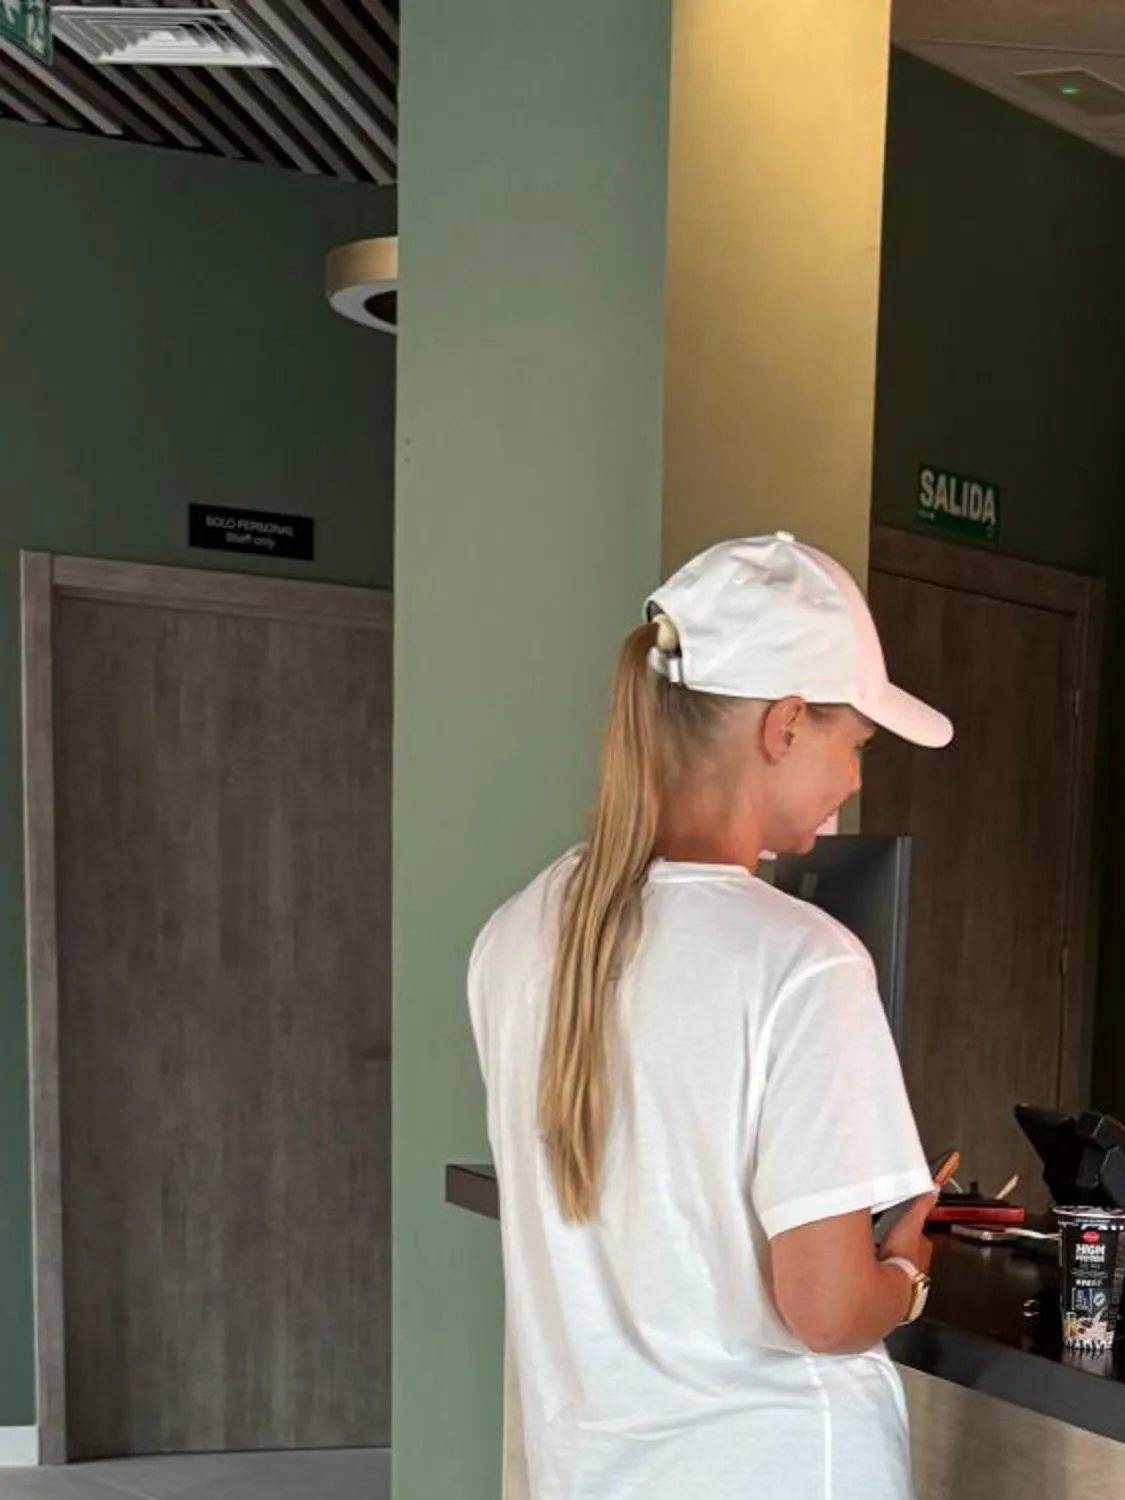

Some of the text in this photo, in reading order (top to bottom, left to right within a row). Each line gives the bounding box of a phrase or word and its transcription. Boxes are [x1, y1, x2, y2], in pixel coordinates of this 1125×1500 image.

[920, 469, 996, 525] SALIDA
[205, 514, 295, 538] SOLO PERSONAL
